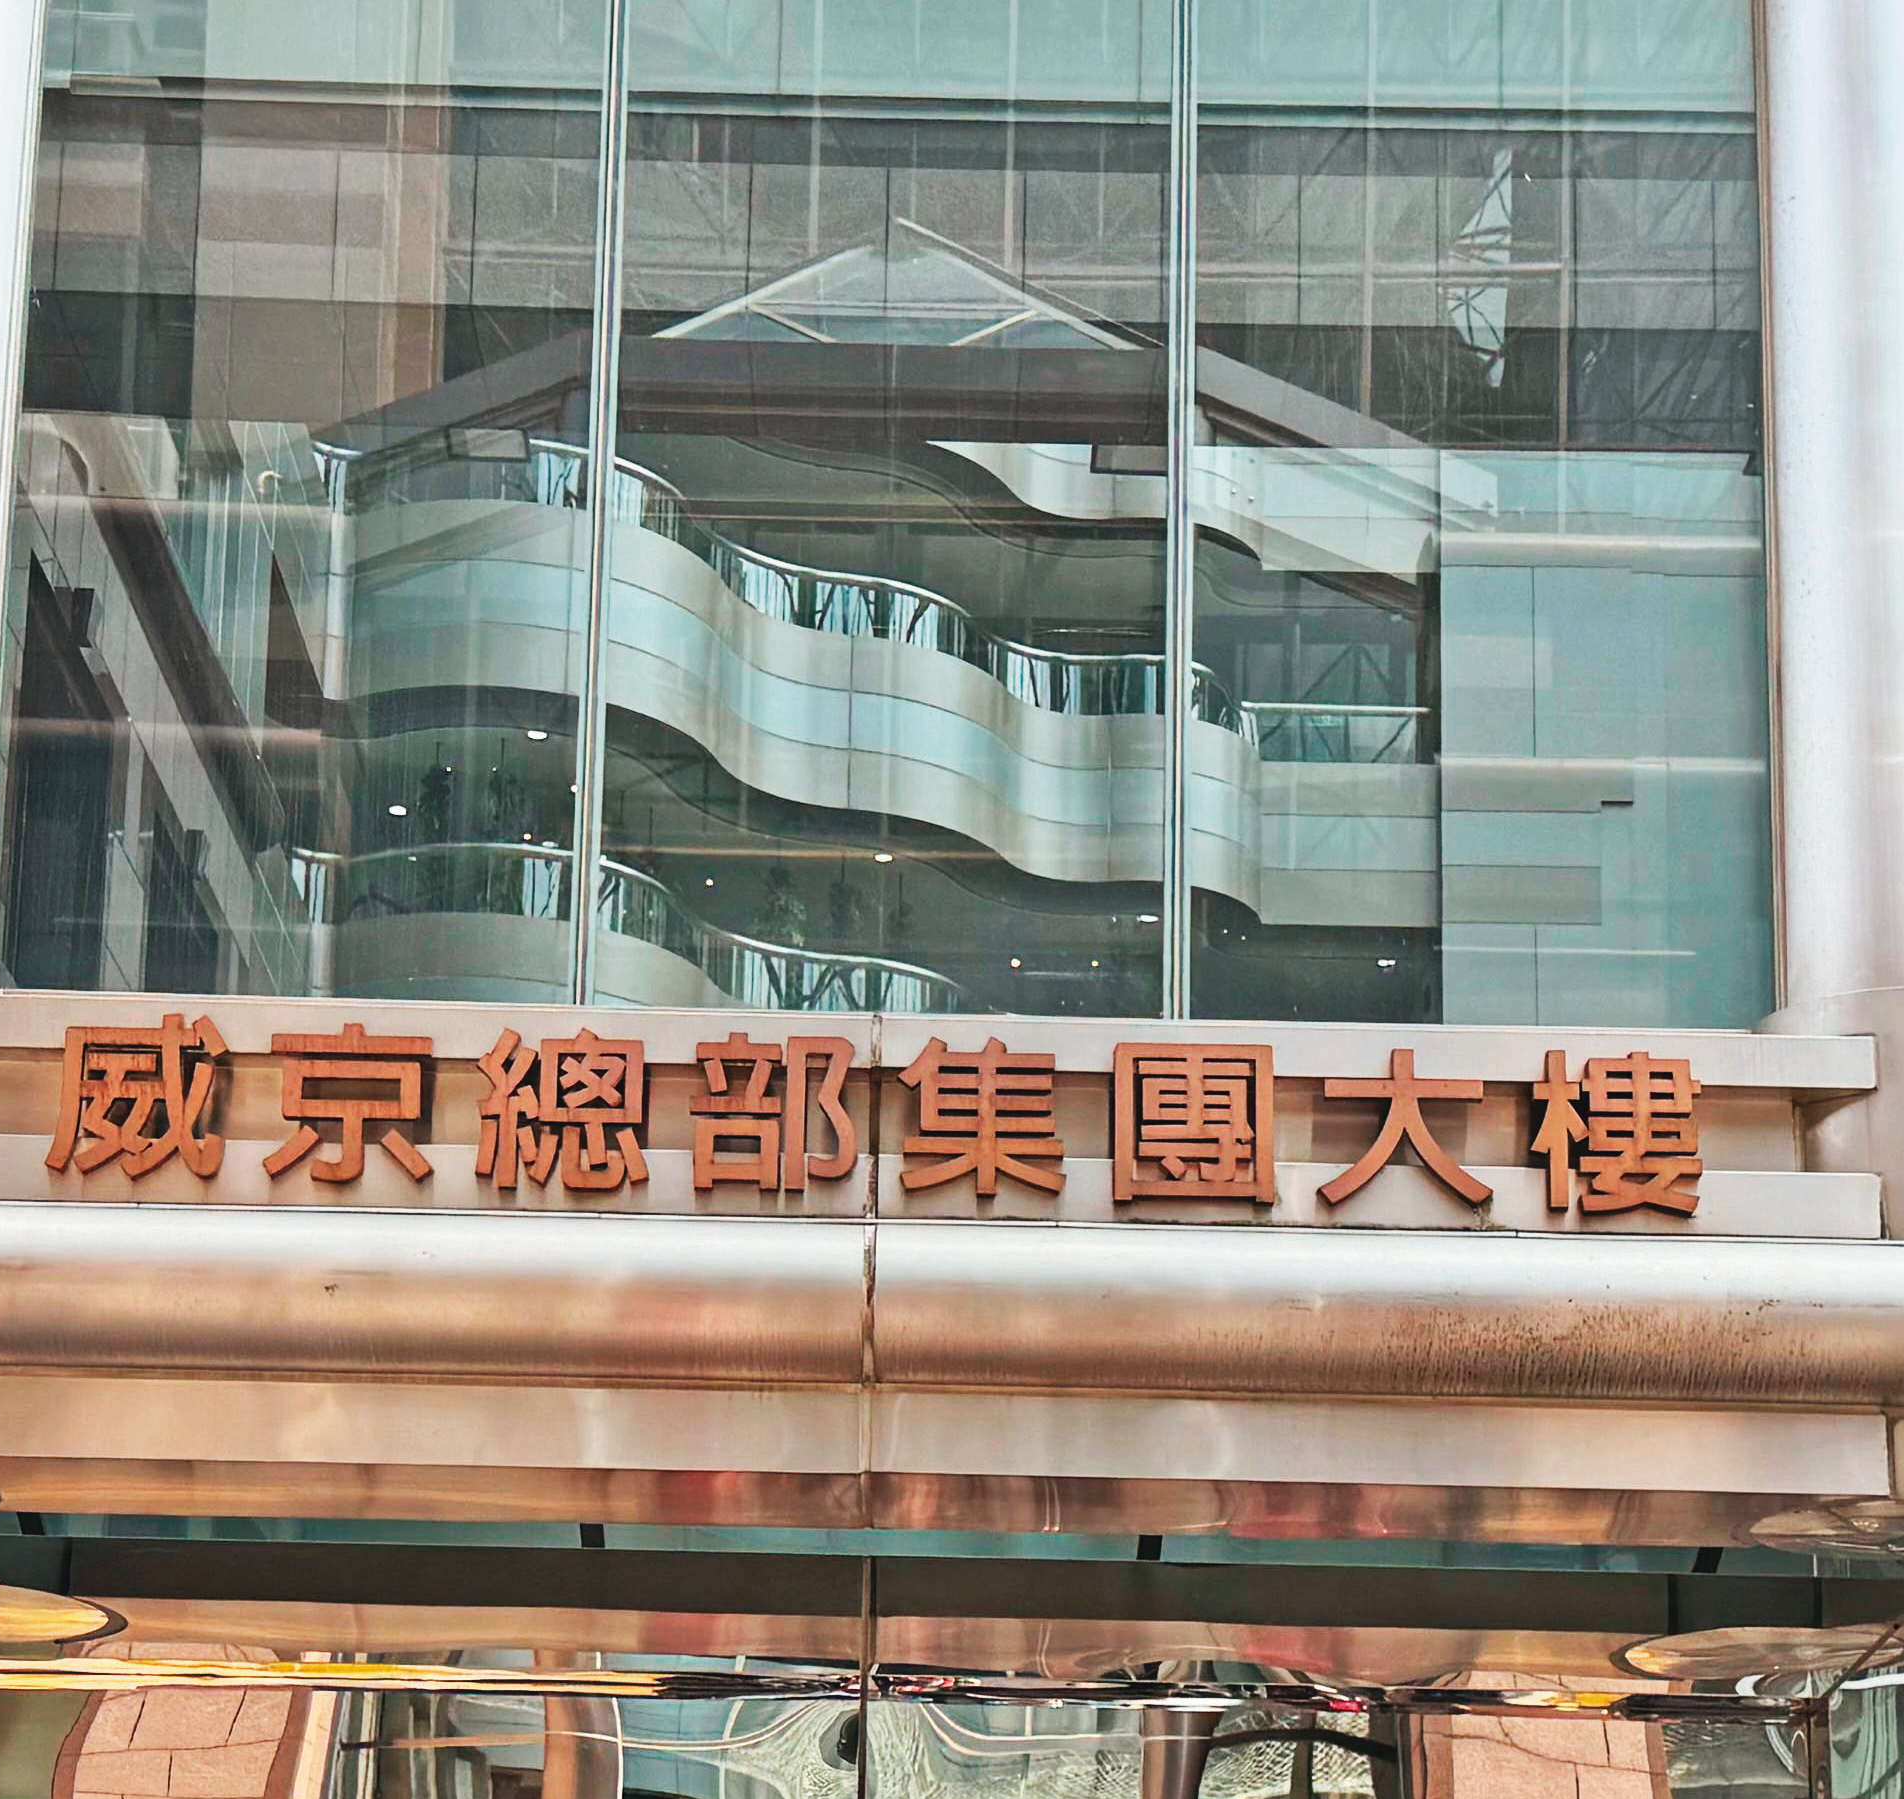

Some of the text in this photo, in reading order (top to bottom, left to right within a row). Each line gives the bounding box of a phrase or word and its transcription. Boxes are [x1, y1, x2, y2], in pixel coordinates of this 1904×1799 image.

[44, 1012, 1702, 1217] 威京總部集團大樓
